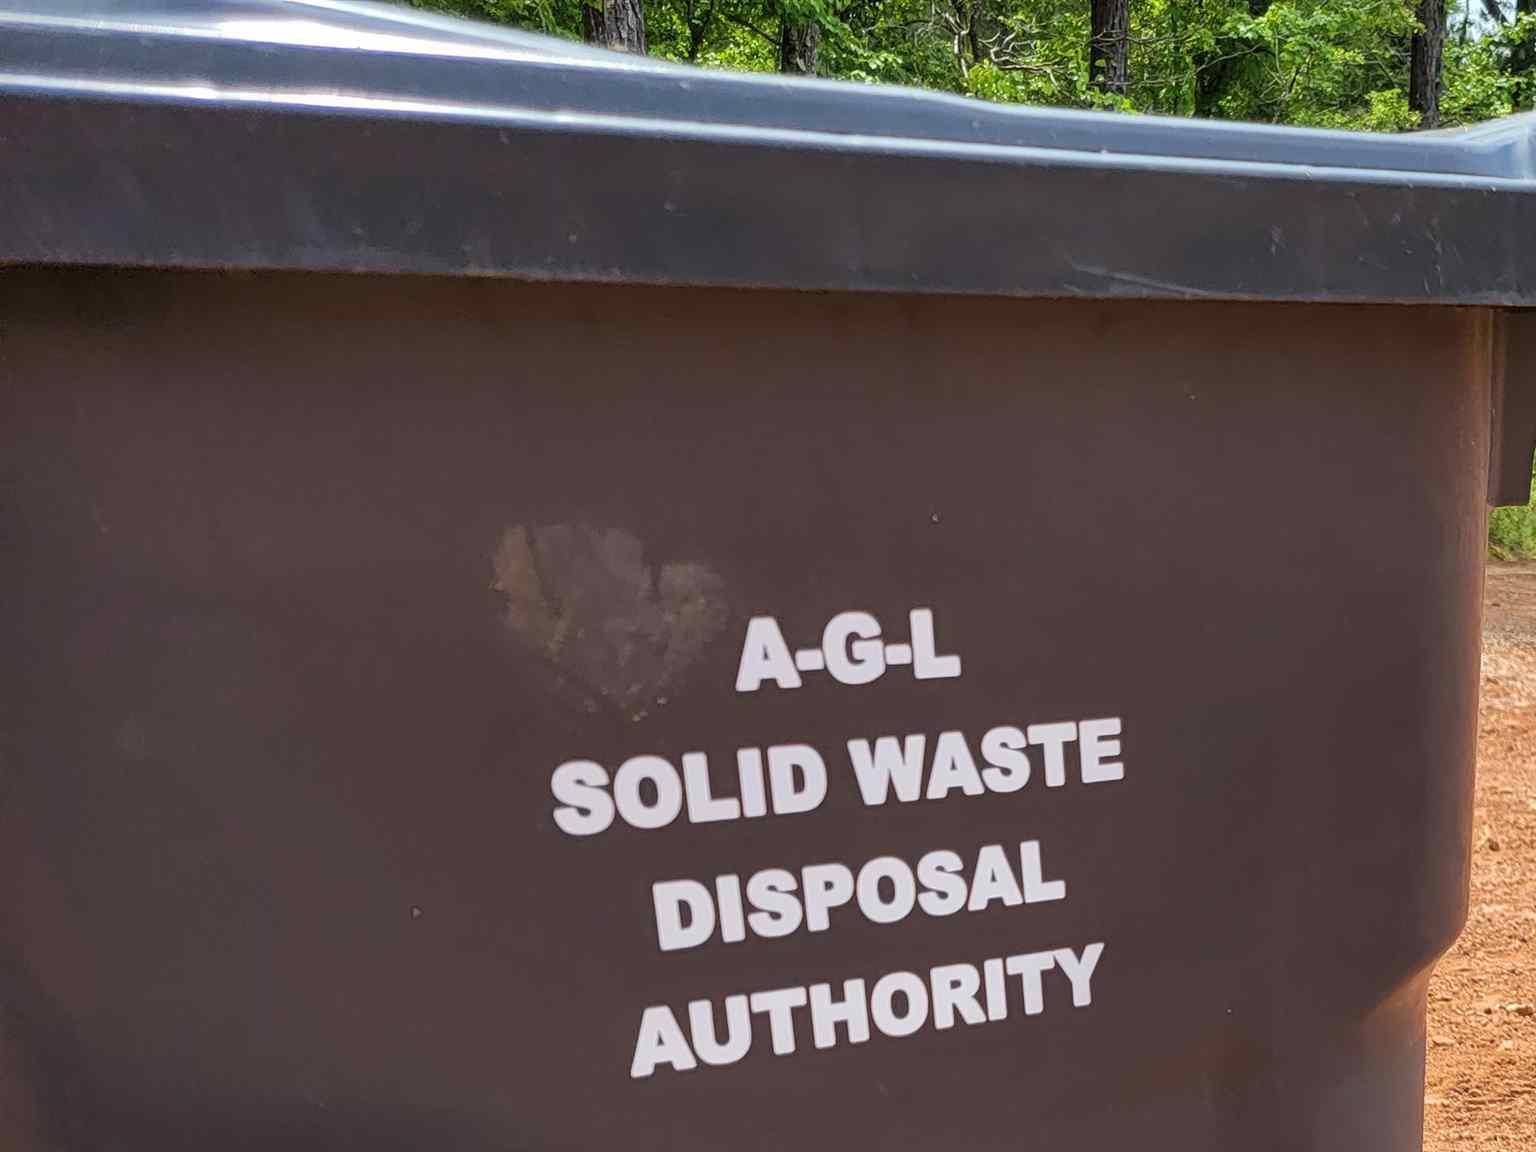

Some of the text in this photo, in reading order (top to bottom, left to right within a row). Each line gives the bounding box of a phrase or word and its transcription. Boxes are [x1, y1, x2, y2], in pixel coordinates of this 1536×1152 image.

[735, 609, 962, 692] A-G-L
[551, 717, 1125, 835] SOLID WASTE
[652, 840, 1067, 951] DISPOSAL
[630, 942, 1106, 1078] AUTHORITY
